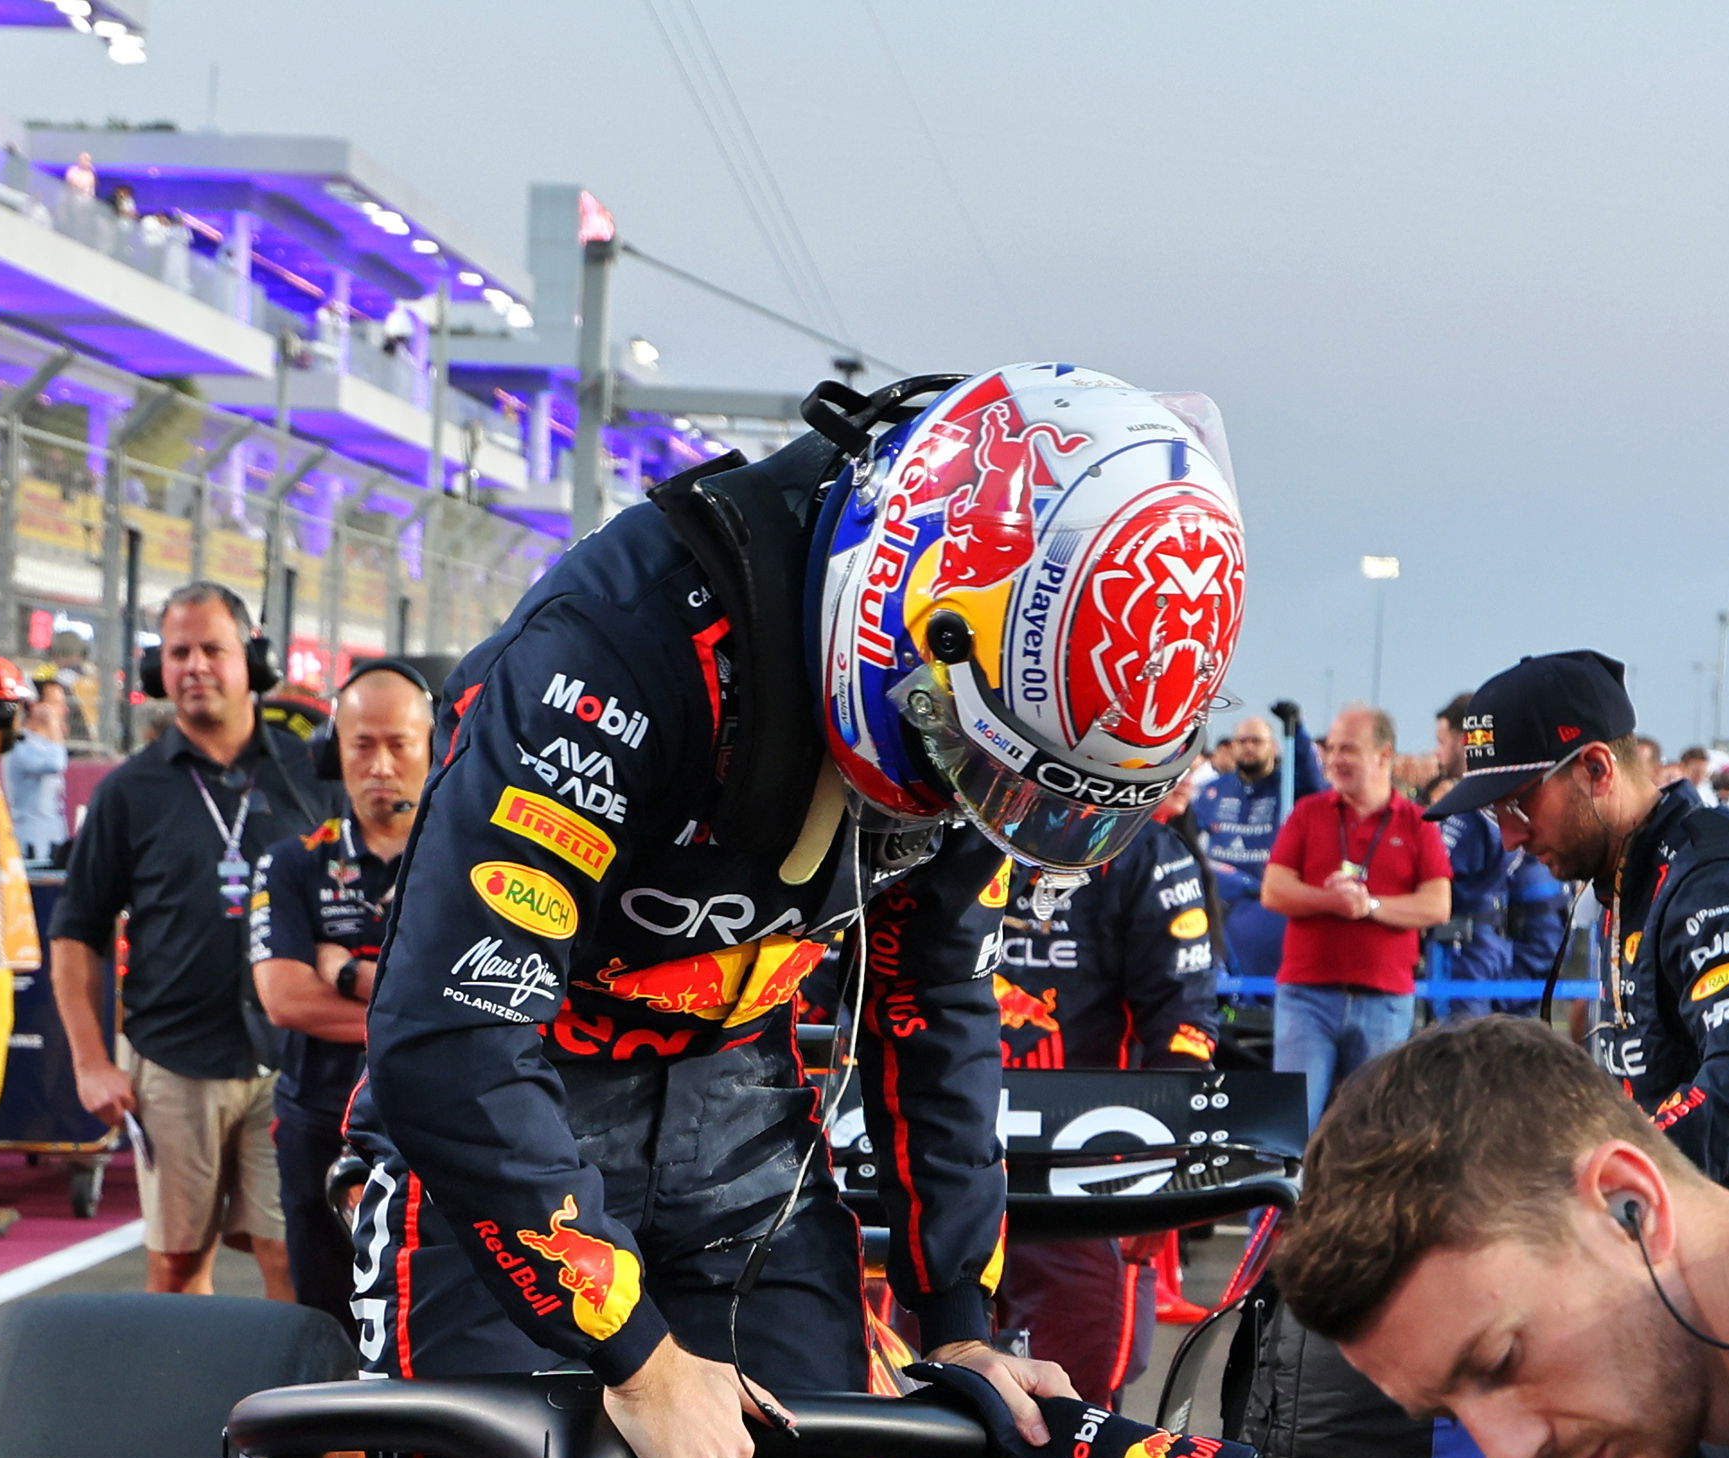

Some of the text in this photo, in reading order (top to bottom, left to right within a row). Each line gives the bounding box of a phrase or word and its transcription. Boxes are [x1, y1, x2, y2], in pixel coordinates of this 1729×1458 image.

[542, 673, 650, 750] Mobil
[540, 737, 615, 787] AVA
[506, 796, 610, 870] PIRELLI
[506, 879, 569, 930] RAUCH
